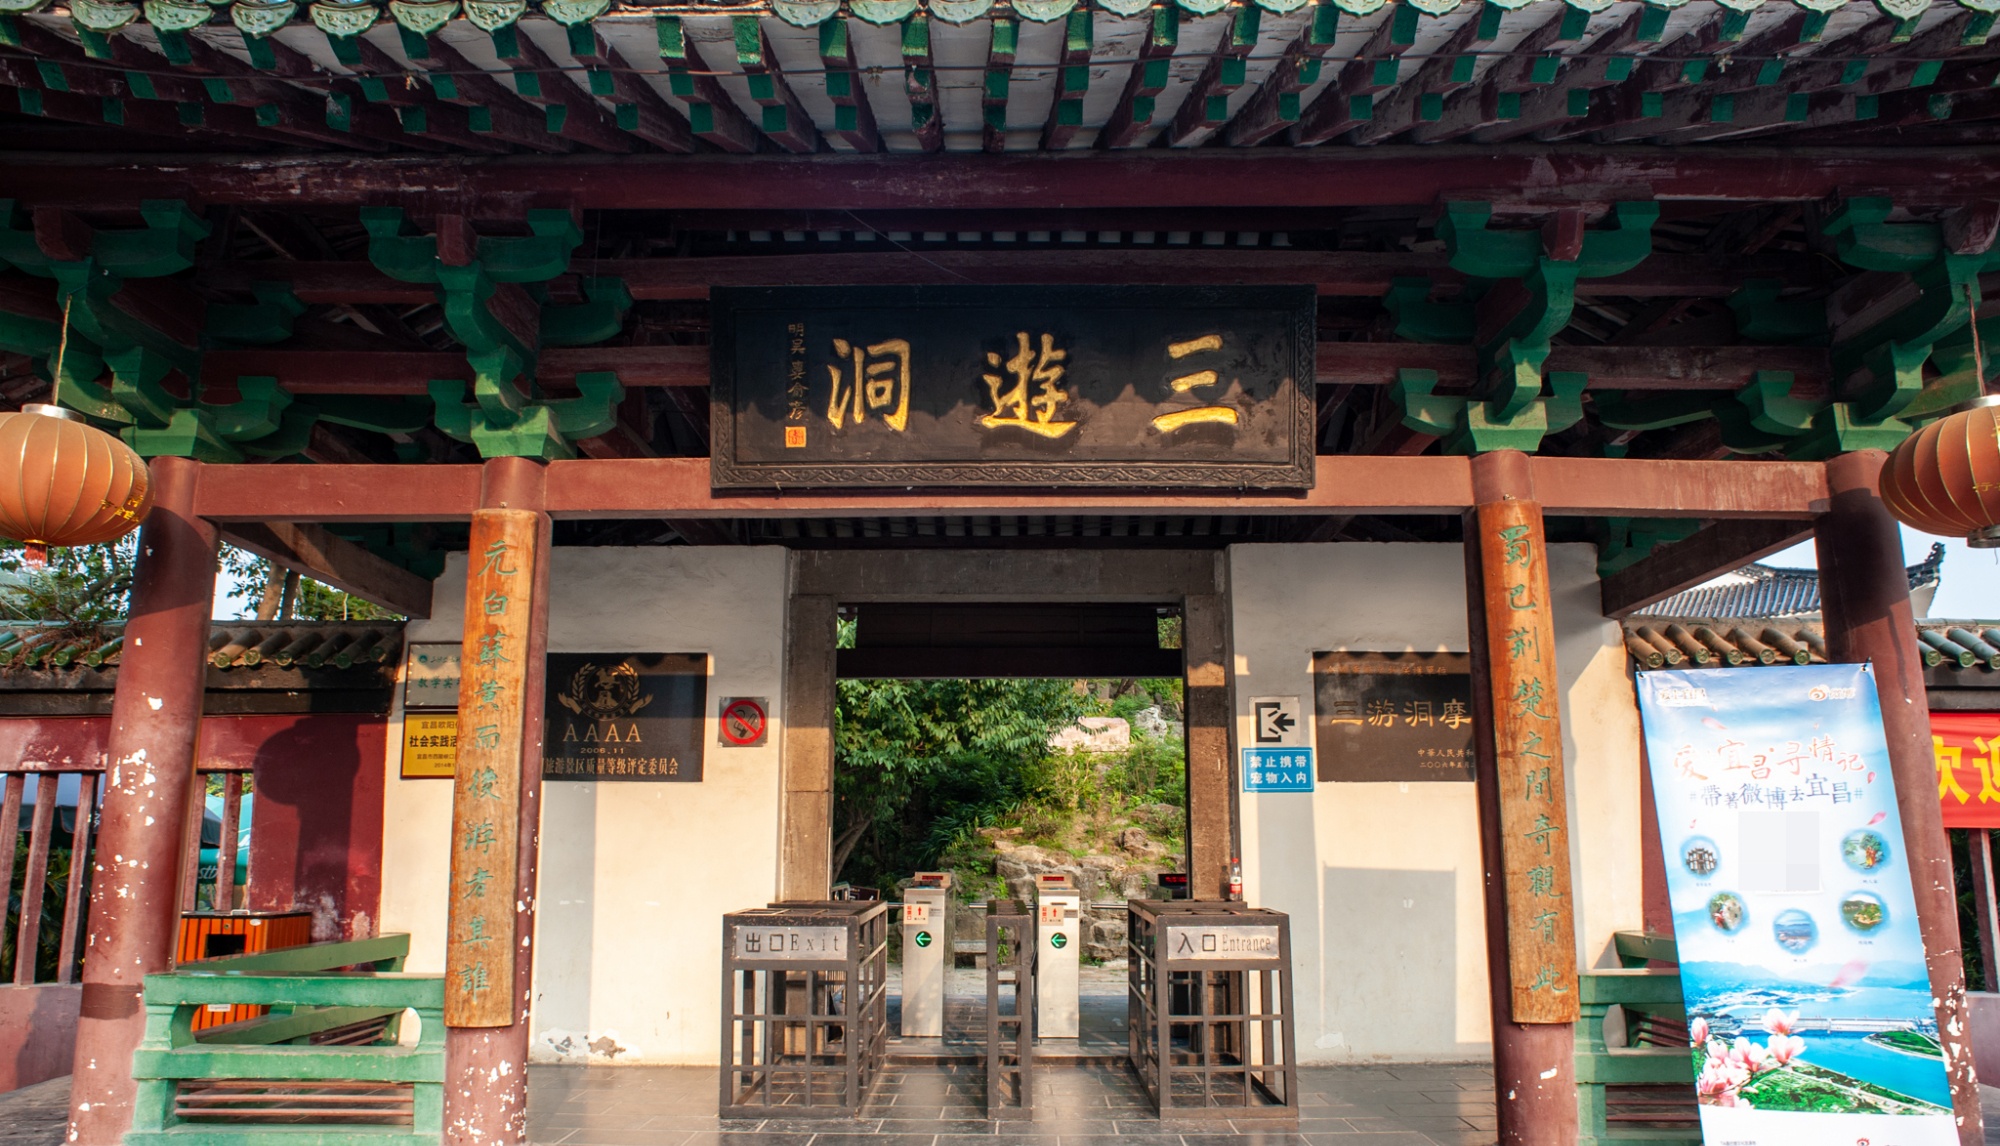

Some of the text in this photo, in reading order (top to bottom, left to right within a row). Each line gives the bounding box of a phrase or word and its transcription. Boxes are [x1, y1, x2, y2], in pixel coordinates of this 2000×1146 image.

[580, 747, 624, 755] 2006.11
[542, 757, 678, 776] 旅游景区质量等级评定委员会
[1250, 755, 1307, 768] 禁止携带
[1250, 771, 1307, 784] 宠物入内
[745, 932, 839, 953] 出口 Exit
[1177, 932, 1271, 954] 入口 Entrance
